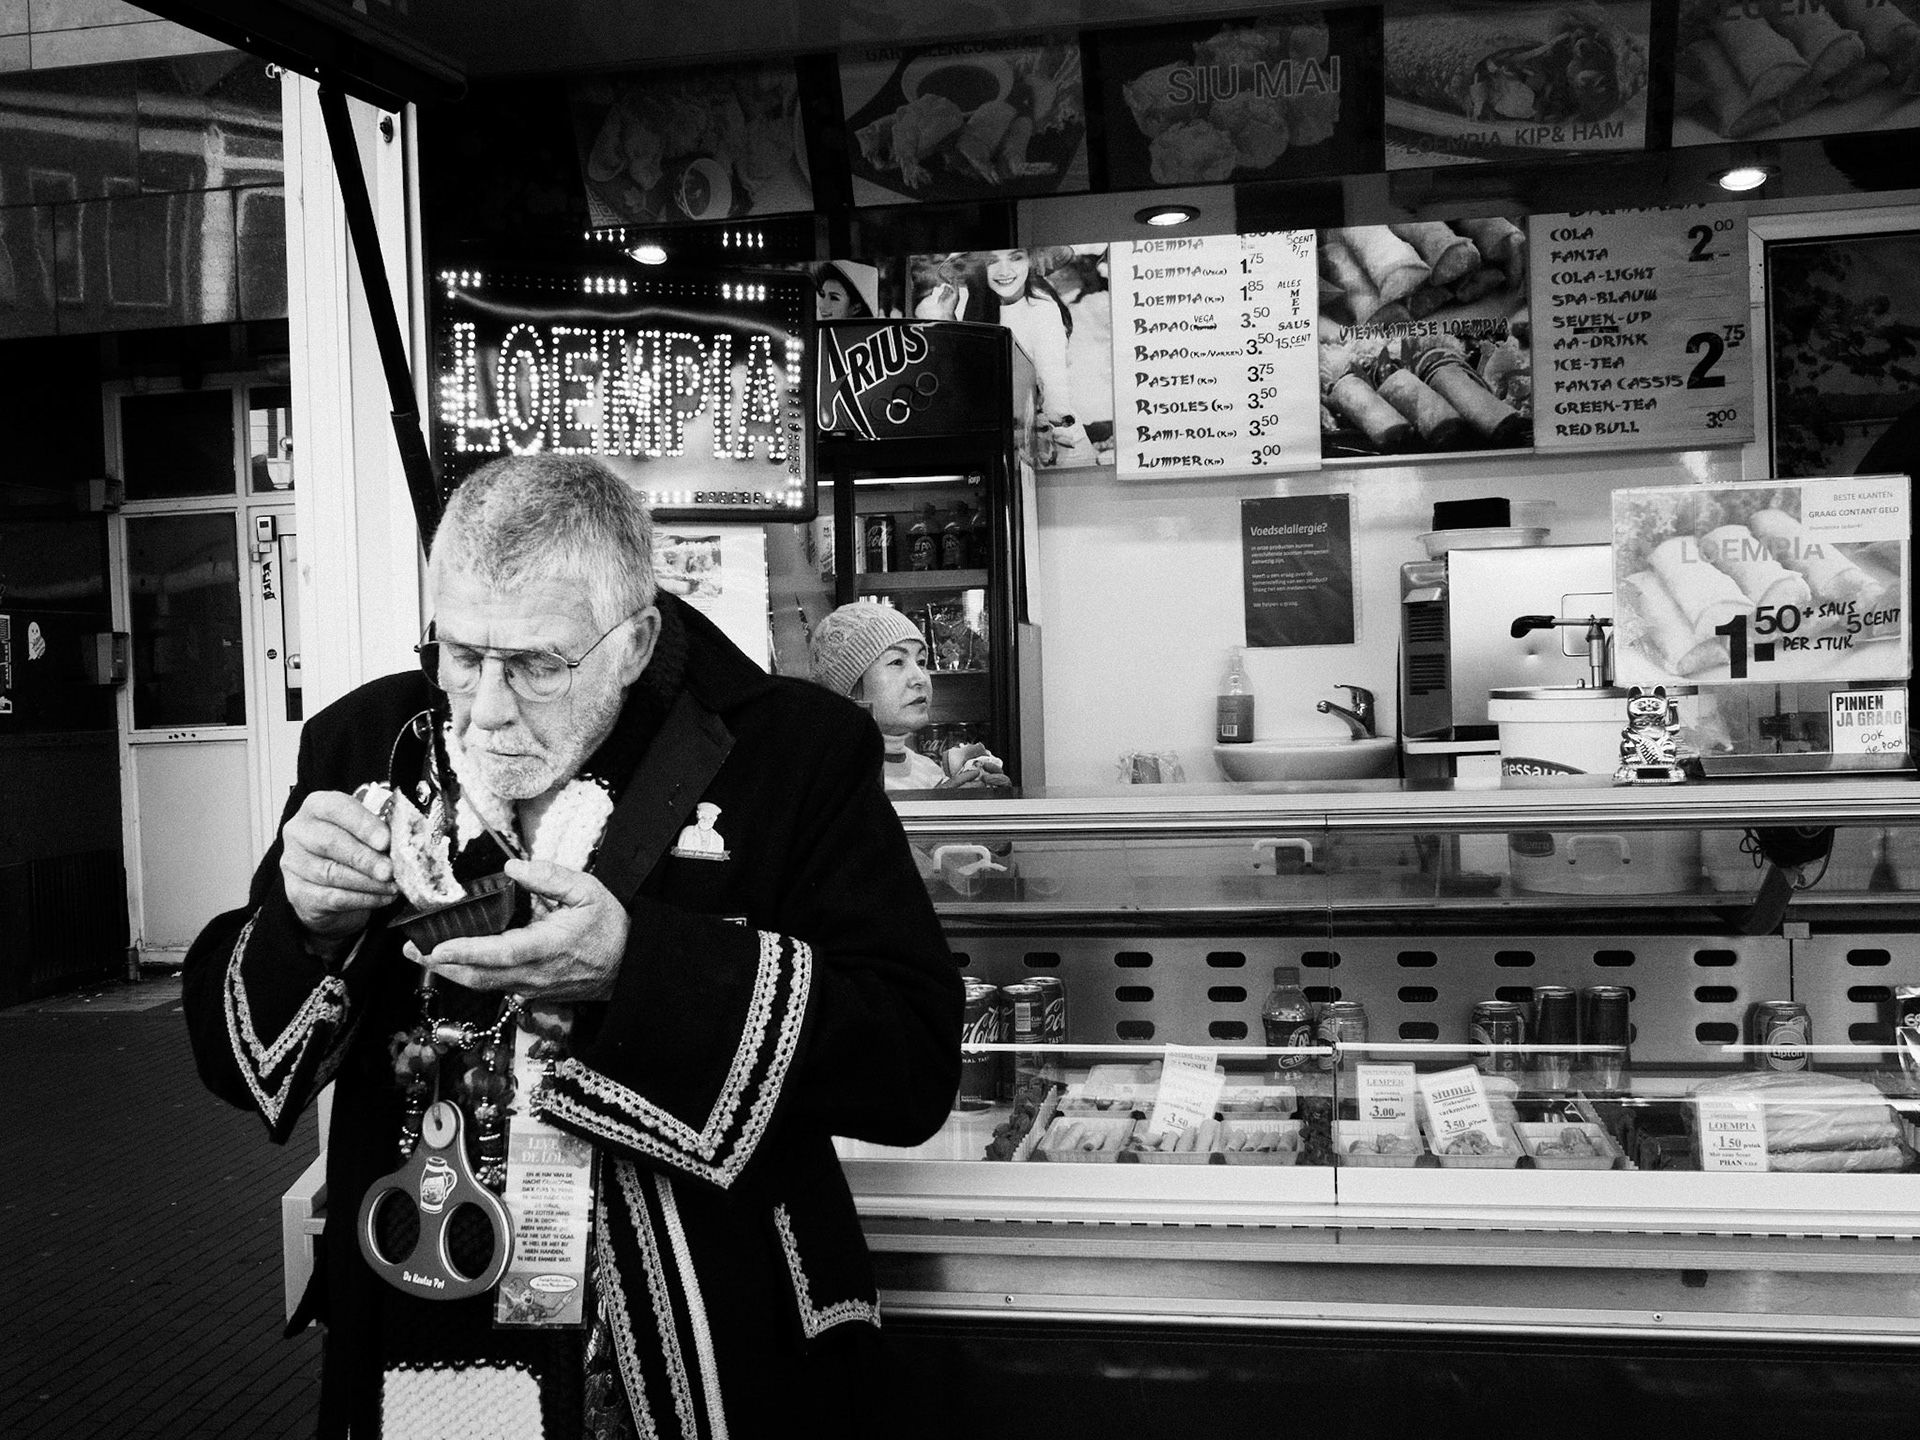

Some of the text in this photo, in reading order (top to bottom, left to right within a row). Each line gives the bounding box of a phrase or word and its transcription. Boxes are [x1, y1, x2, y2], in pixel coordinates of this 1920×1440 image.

[1167, 55, 1340, 105] SIU MAI
[1572, 121, 1625, 141] HAM
[1550, 227, 1594, 242] COLA
[1132, 238, 1204, 254] LOEMPIA
[1551, 248, 1608, 263] FANTA
[1132, 265, 1202, 280] LOEMPIA
[1551, 266, 1658, 285] COLA-LIGHT
[1277, 279, 1301, 289] ALLES
[1133, 292, 1203, 308] LOEMPIA
[1551, 289, 1658, 307] SPA-BLAUW
[1134, 318, 1189, 334] BAPAO
[1194, 315, 1214, 323] VEGA
[1278, 319, 1311, 331] SAUS
[1552, 311, 1652, 328] SEVEN-UP
[1340, 317, 1509, 343] VIETNAMESE LOEMPIA
[1290, 333, 1311, 344] CENT
[1553, 333, 1648, 350] AA-DRINK
[1134, 345, 1189, 361] BAPAO
[1554, 356, 1625, 372] ICE-TEA
[1135, 372, 1195, 387] PASTEI
[1554, 374, 1684, 393] FANTA CASSIS
[453, 323, 789, 460] LOEMPIA
[1135, 399, 1208, 415] RISOLES
[1554, 398, 1658, 415] GREEN-TEA
[1136, 425, 1215, 442] BAMI-ROL
[1555, 423, 1592, 436] RED
[1594, 421, 1640, 435] BULL
[1137, 453, 1202, 468] LUMPER
[1833, 490, 1893, 502] BESTE KLANTEN
[1808, 506, 1900, 518] GRAAG CONTANT GELD
[1250, 522, 1328, 536] Voedselallergie?
[1681, 536, 1825, 564] LOEMPIA
[1818, 600, 1857, 618] SAUS
[1863, 608, 1901, 626] CENT
[1783, 634, 1855, 651] PER STUK
[1836, 695, 1883, 711] PINNEN
[1837, 710, 1902, 727] JA GRAAG
[1861, 730, 1884, 743] Ook
[1366, 1079, 1404, 1087] LEMPER
[1431, 1081, 1476, 1101] siumai
[1708, 1122, 1757, 1131] LOEMPIA
